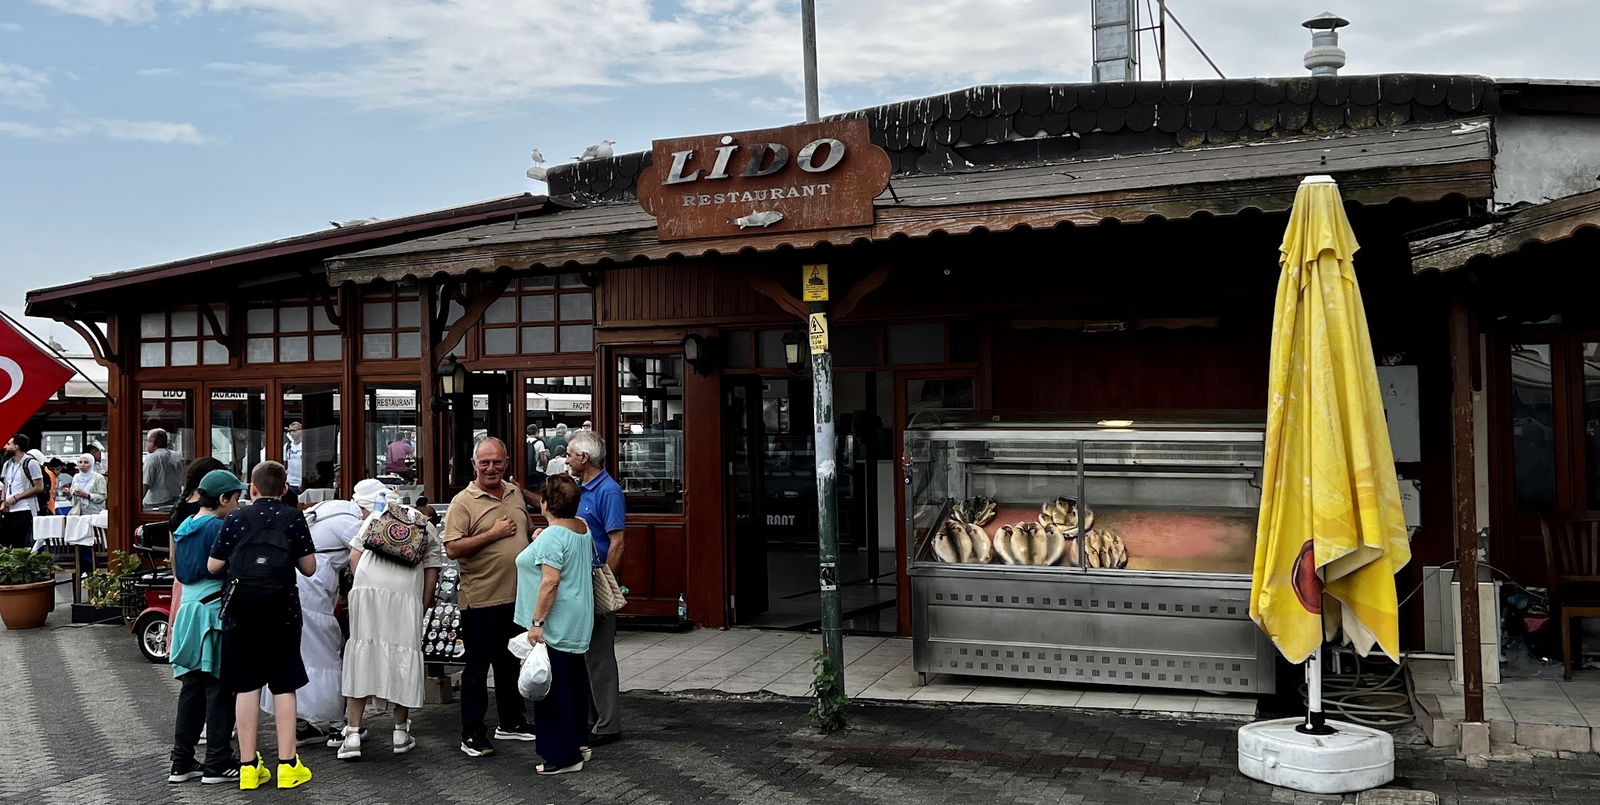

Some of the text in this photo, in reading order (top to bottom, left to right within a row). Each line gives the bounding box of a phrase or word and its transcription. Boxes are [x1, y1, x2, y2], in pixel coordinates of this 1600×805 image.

[661, 135, 846, 186] LİDO
[682, 184, 831, 207] RESTAURANT
[376, 399, 414, 407] RESTAURANT
